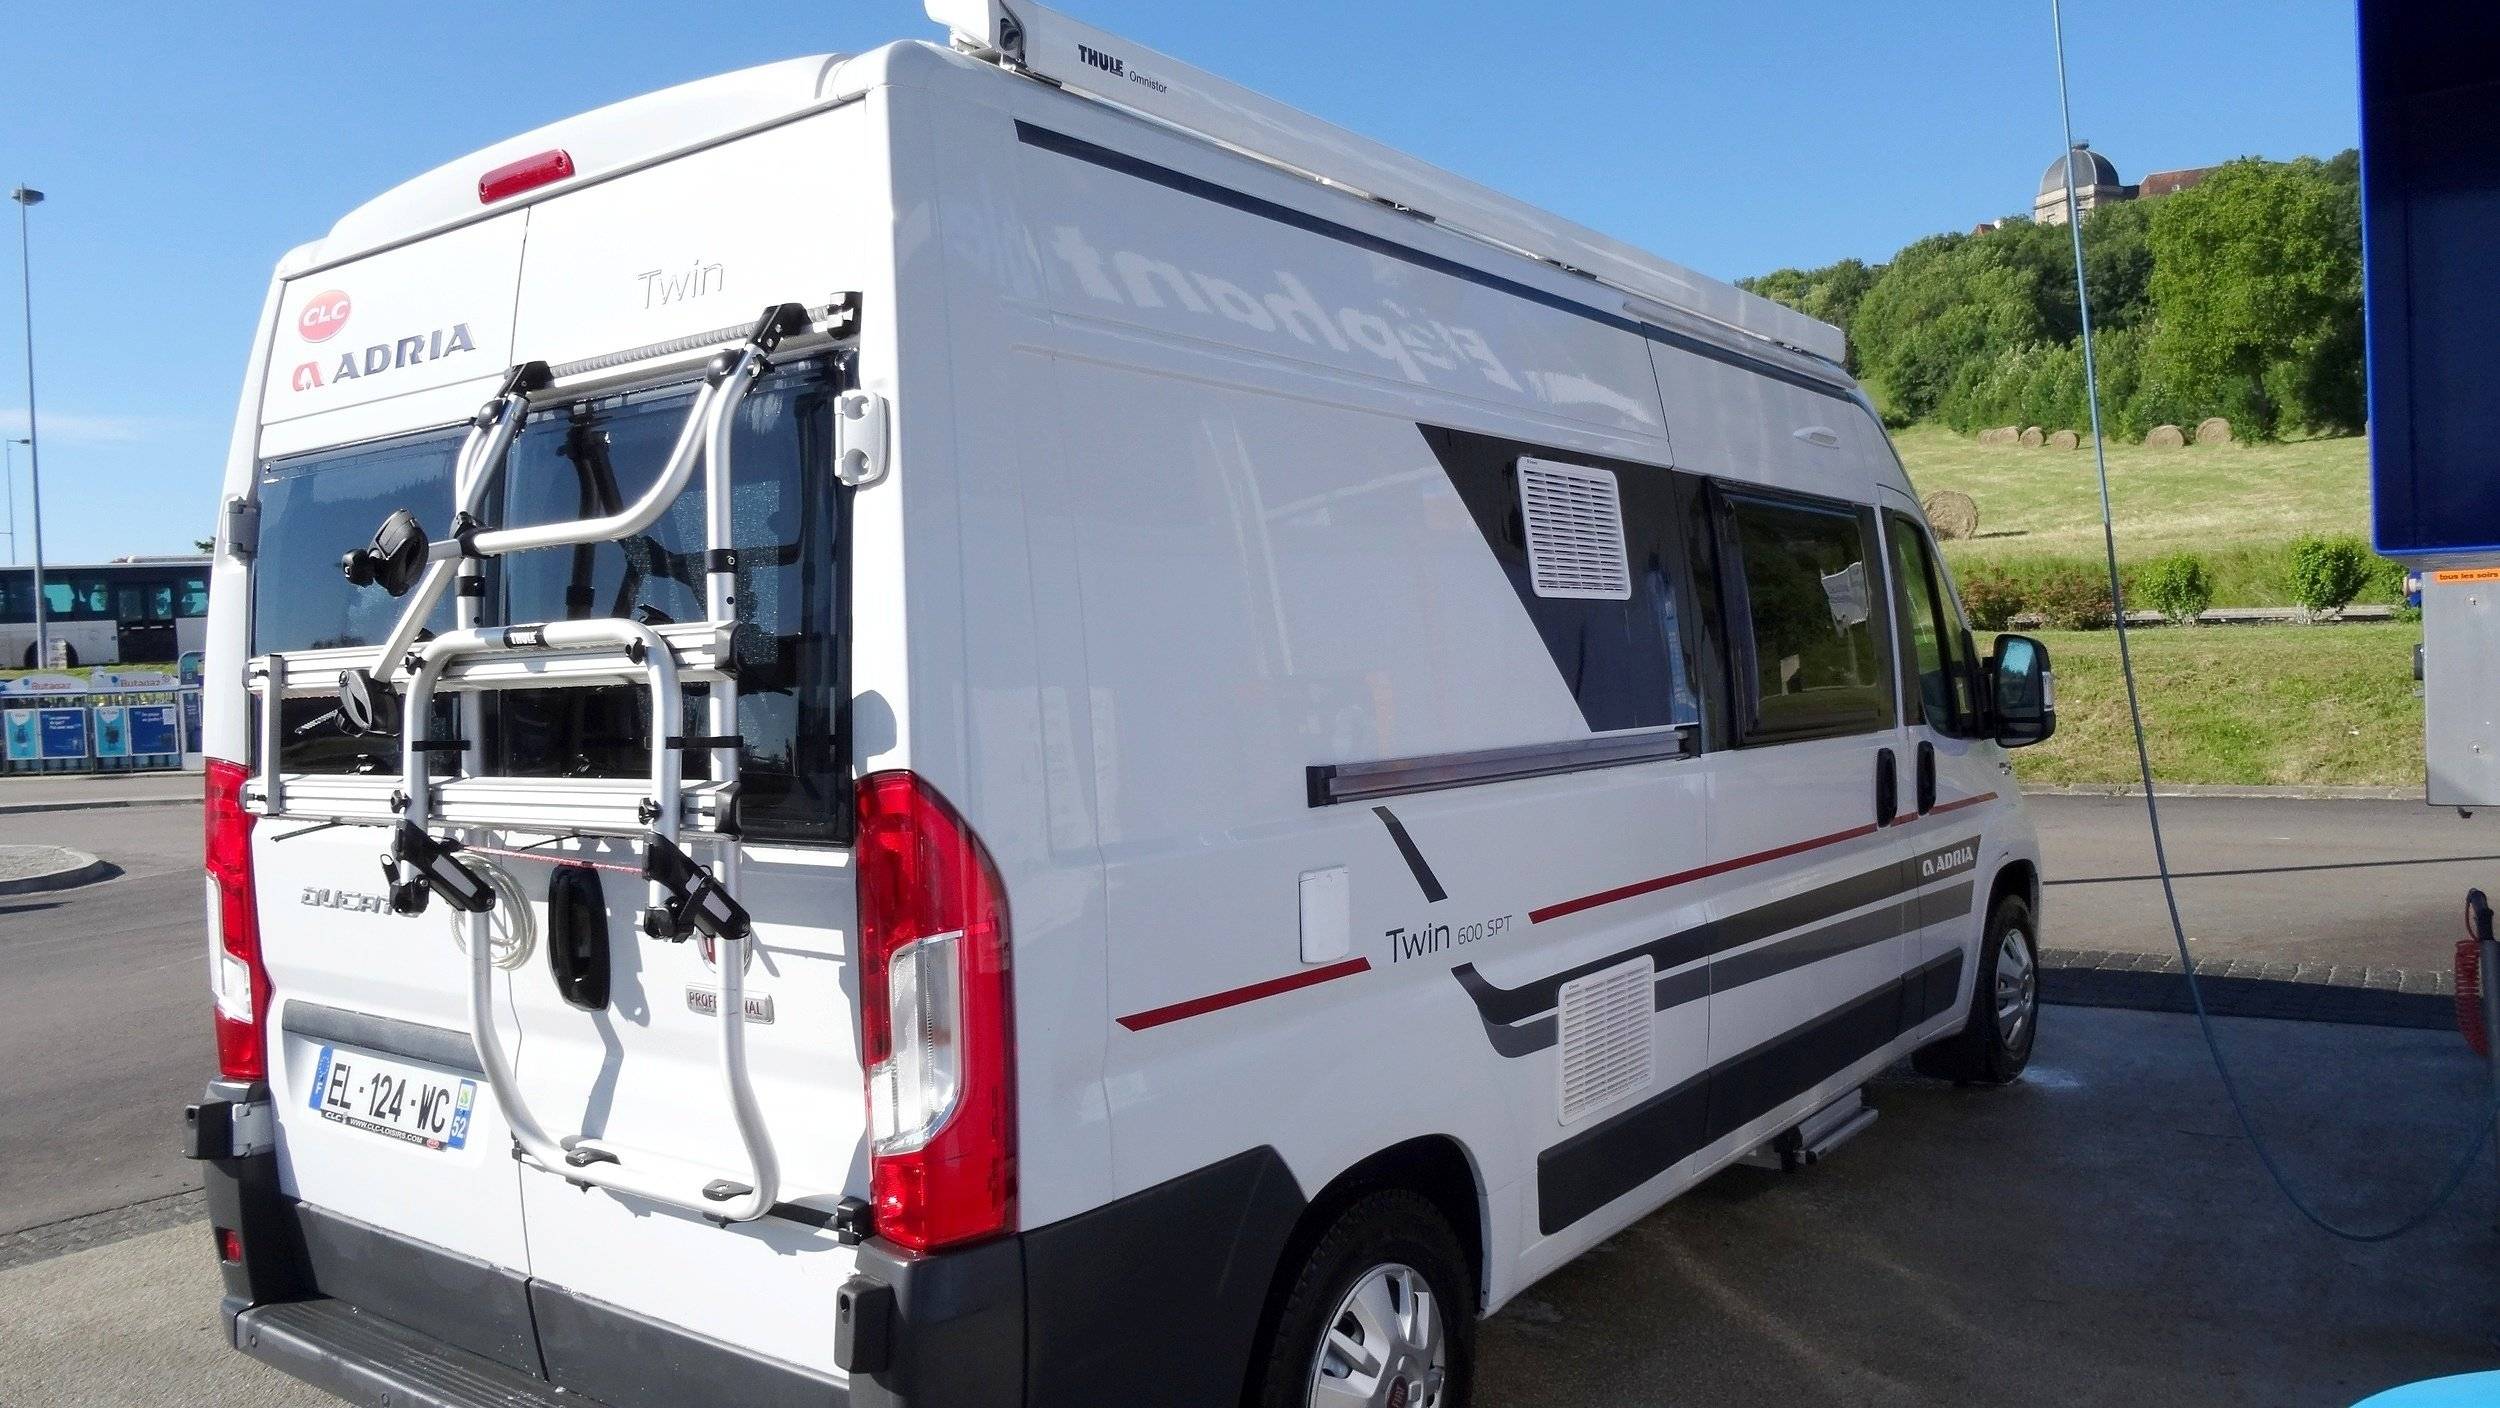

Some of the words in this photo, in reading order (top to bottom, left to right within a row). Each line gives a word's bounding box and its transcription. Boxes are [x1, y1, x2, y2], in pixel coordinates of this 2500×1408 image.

[1078, 44, 1124, 77] THULE
[1129, 70, 1168, 94] Omnistor
[637, 259, 725, 310] Twin
[303, 300, 349, 327] CLC
[332, 322, 477, 384] ADRIA
[1936, 846, 1974, 872] ADRIA
[1385, 922, 1450, 963] Twin
[1457, 923, 1483, 945] 600
[1487, 914, 1513, 937] SPT
[325, 1110, 342, 1122] CLC
[349, 1118, 423, 1144] WWW.CLC-LOISIRS.COM
[451, 1117, 467, 1140] 52
